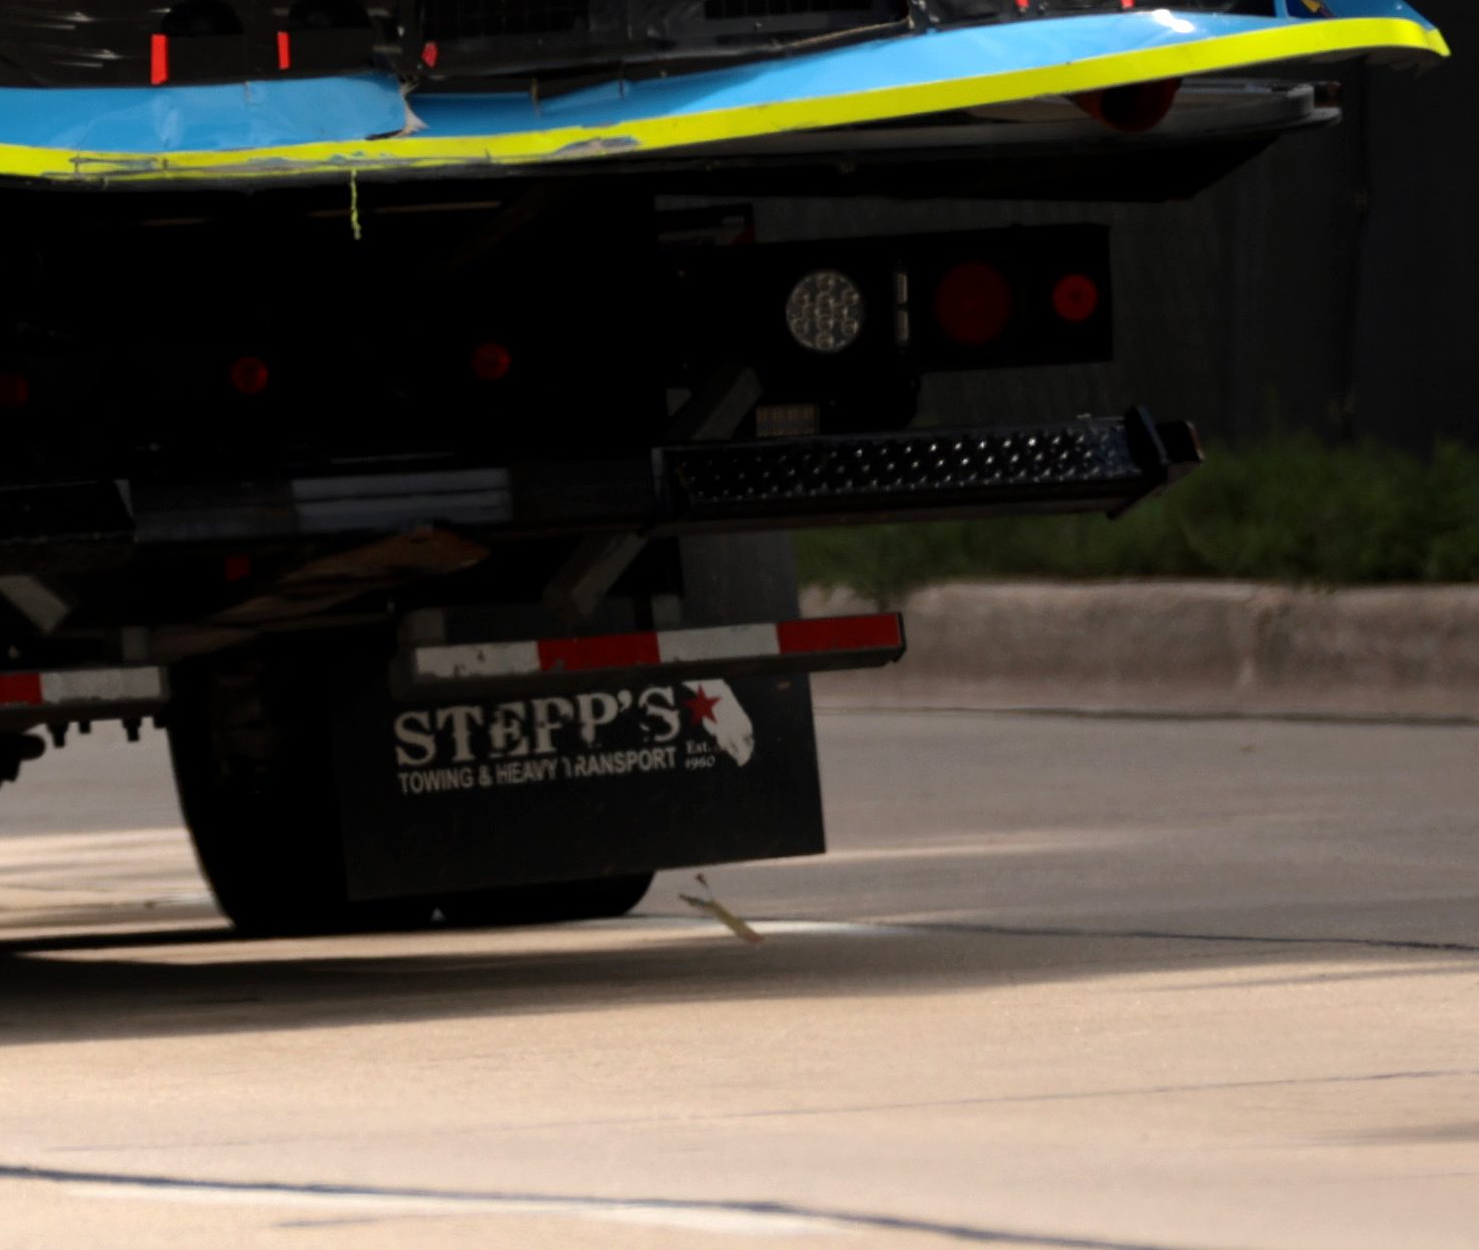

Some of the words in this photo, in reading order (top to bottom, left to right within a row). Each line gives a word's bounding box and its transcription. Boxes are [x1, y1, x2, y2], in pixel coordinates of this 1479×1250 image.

[392, 684, 681, 767] STEPP'S
[397, 768, 475, 797] TOWING
[478, 767, 496, 788] &
[497, 758, 559, 786] HEAVY
[560, 746, 679, 781] TRANSPORT
